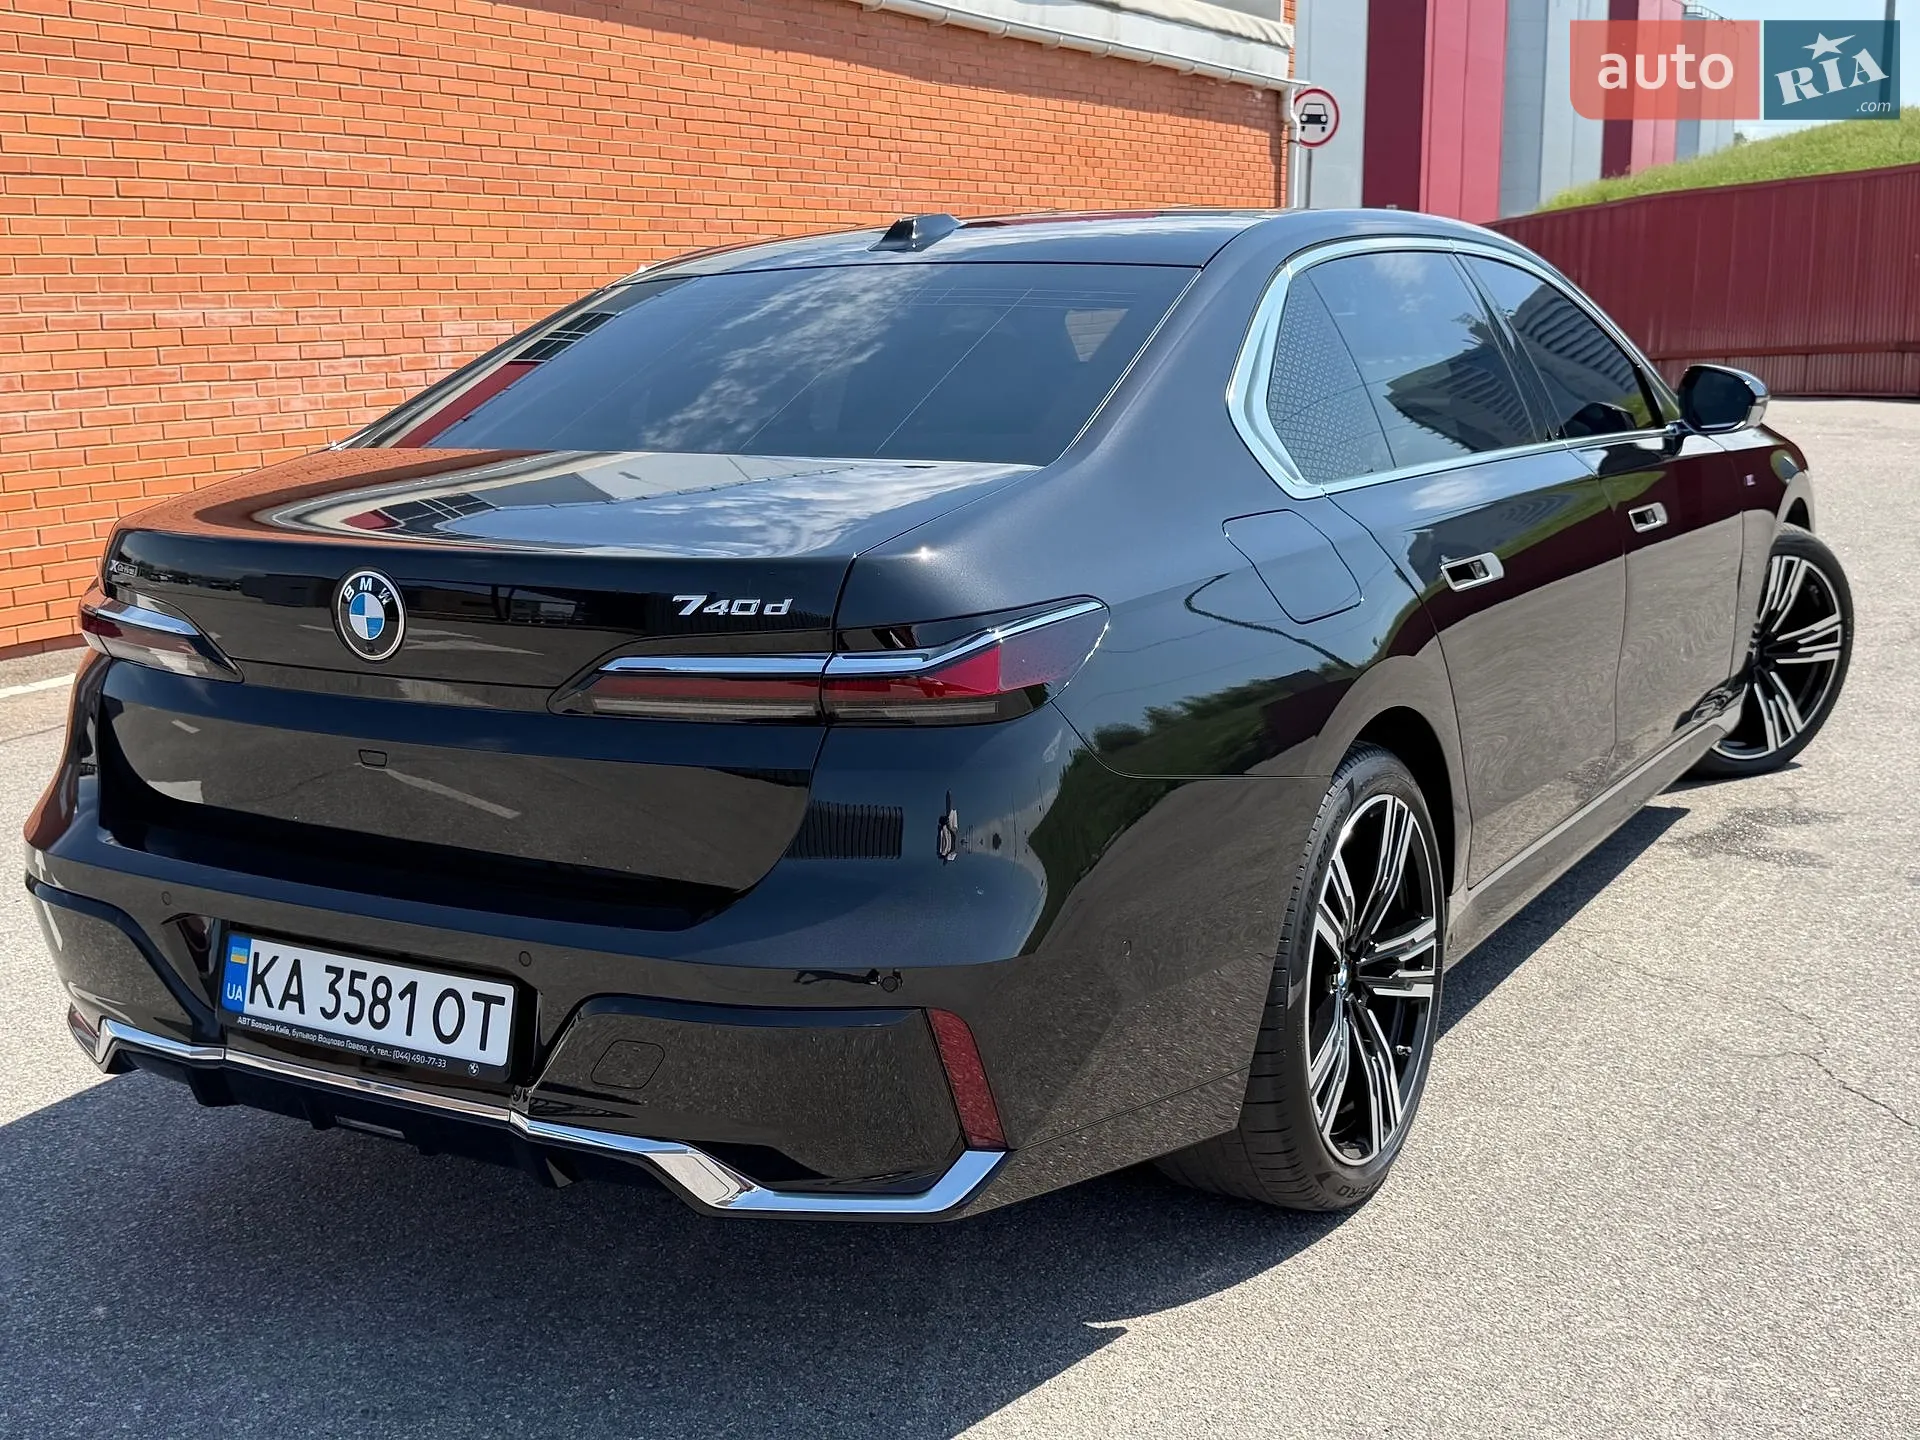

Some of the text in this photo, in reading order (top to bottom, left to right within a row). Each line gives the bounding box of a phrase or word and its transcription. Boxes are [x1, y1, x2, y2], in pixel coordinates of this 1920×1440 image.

[343, 577, 392, 606] BMW
[226, 982, 243, 1003] UA
[249, 951, 506, 1051] KA 3581 OT
[392, 1050, 411, 1062] (044)
[411, 1054, 447, 1068] 490-77-33
